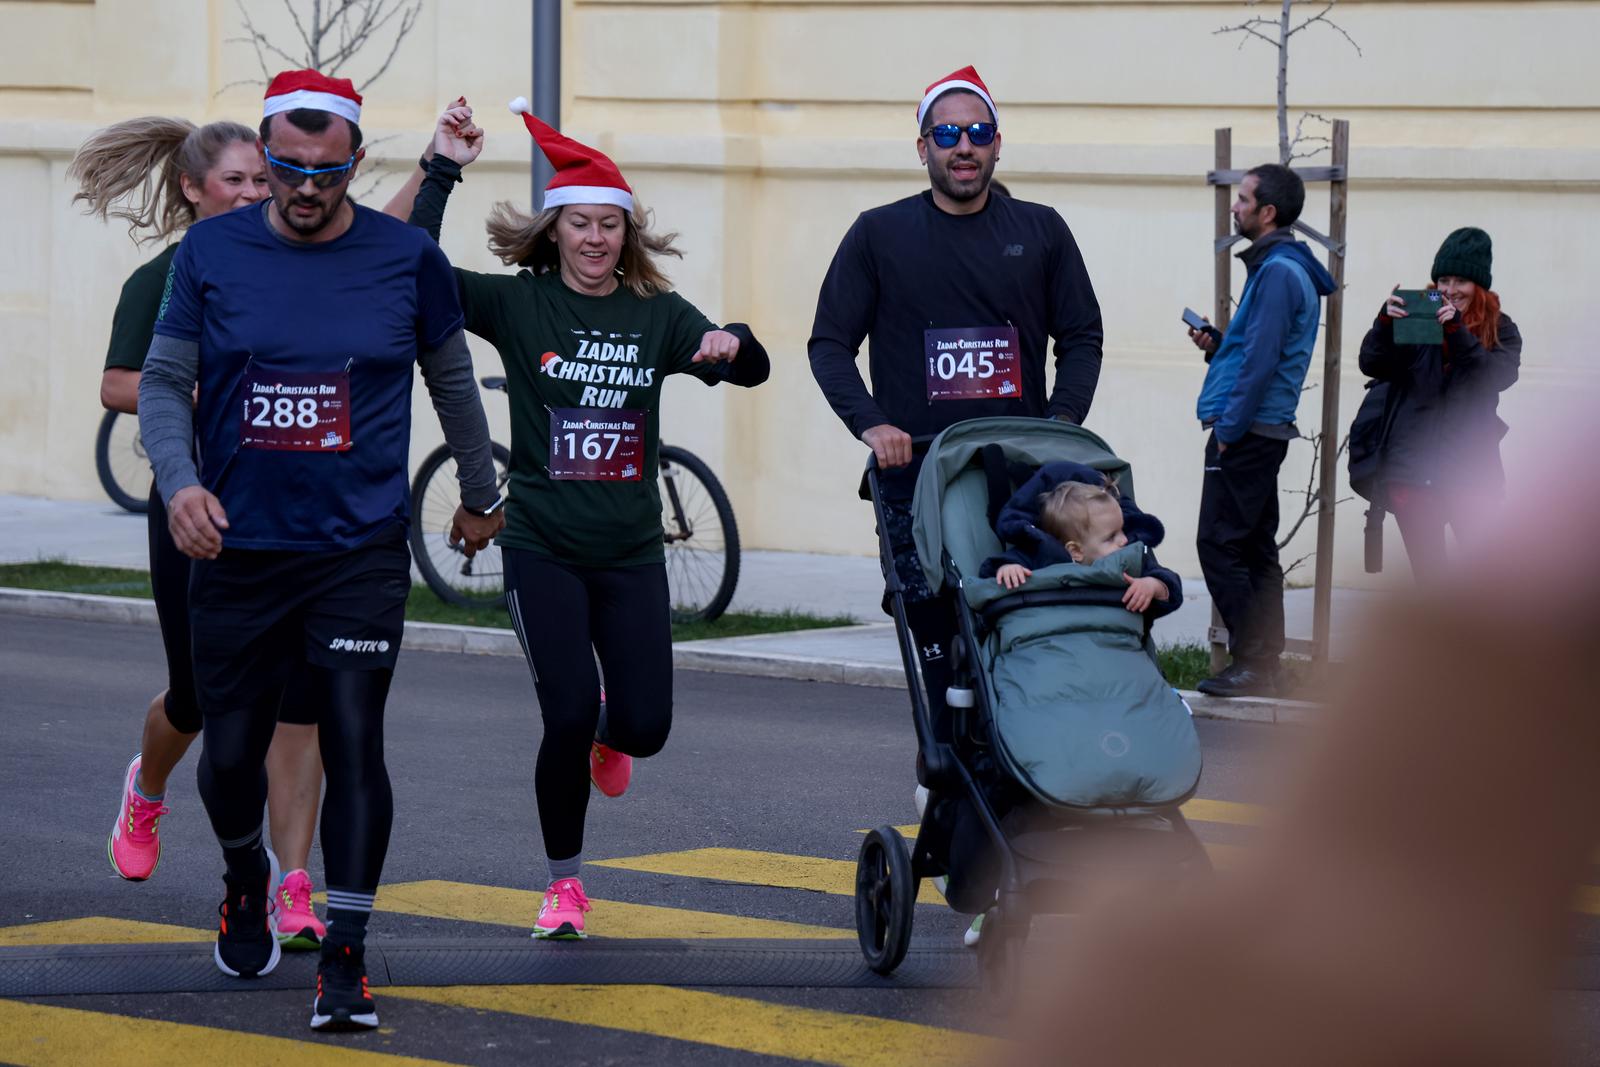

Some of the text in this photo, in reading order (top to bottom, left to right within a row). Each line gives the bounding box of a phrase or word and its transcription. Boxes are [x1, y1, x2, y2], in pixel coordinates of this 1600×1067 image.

[576, 340, 639, 363] ZADAR
[937, 340, 958, 350] ZADAR
[546, 357, 655, 387] CHRISTMAS
[937, 351, 995, 380] 045
[252, 382, 275, 393] ZADAR
[580, 386, 628, 408] RUN
[251, 396, 319, 429] 288
[563, 420, 584, 430] ZADAR
[564, 432, 621, 460] 167
